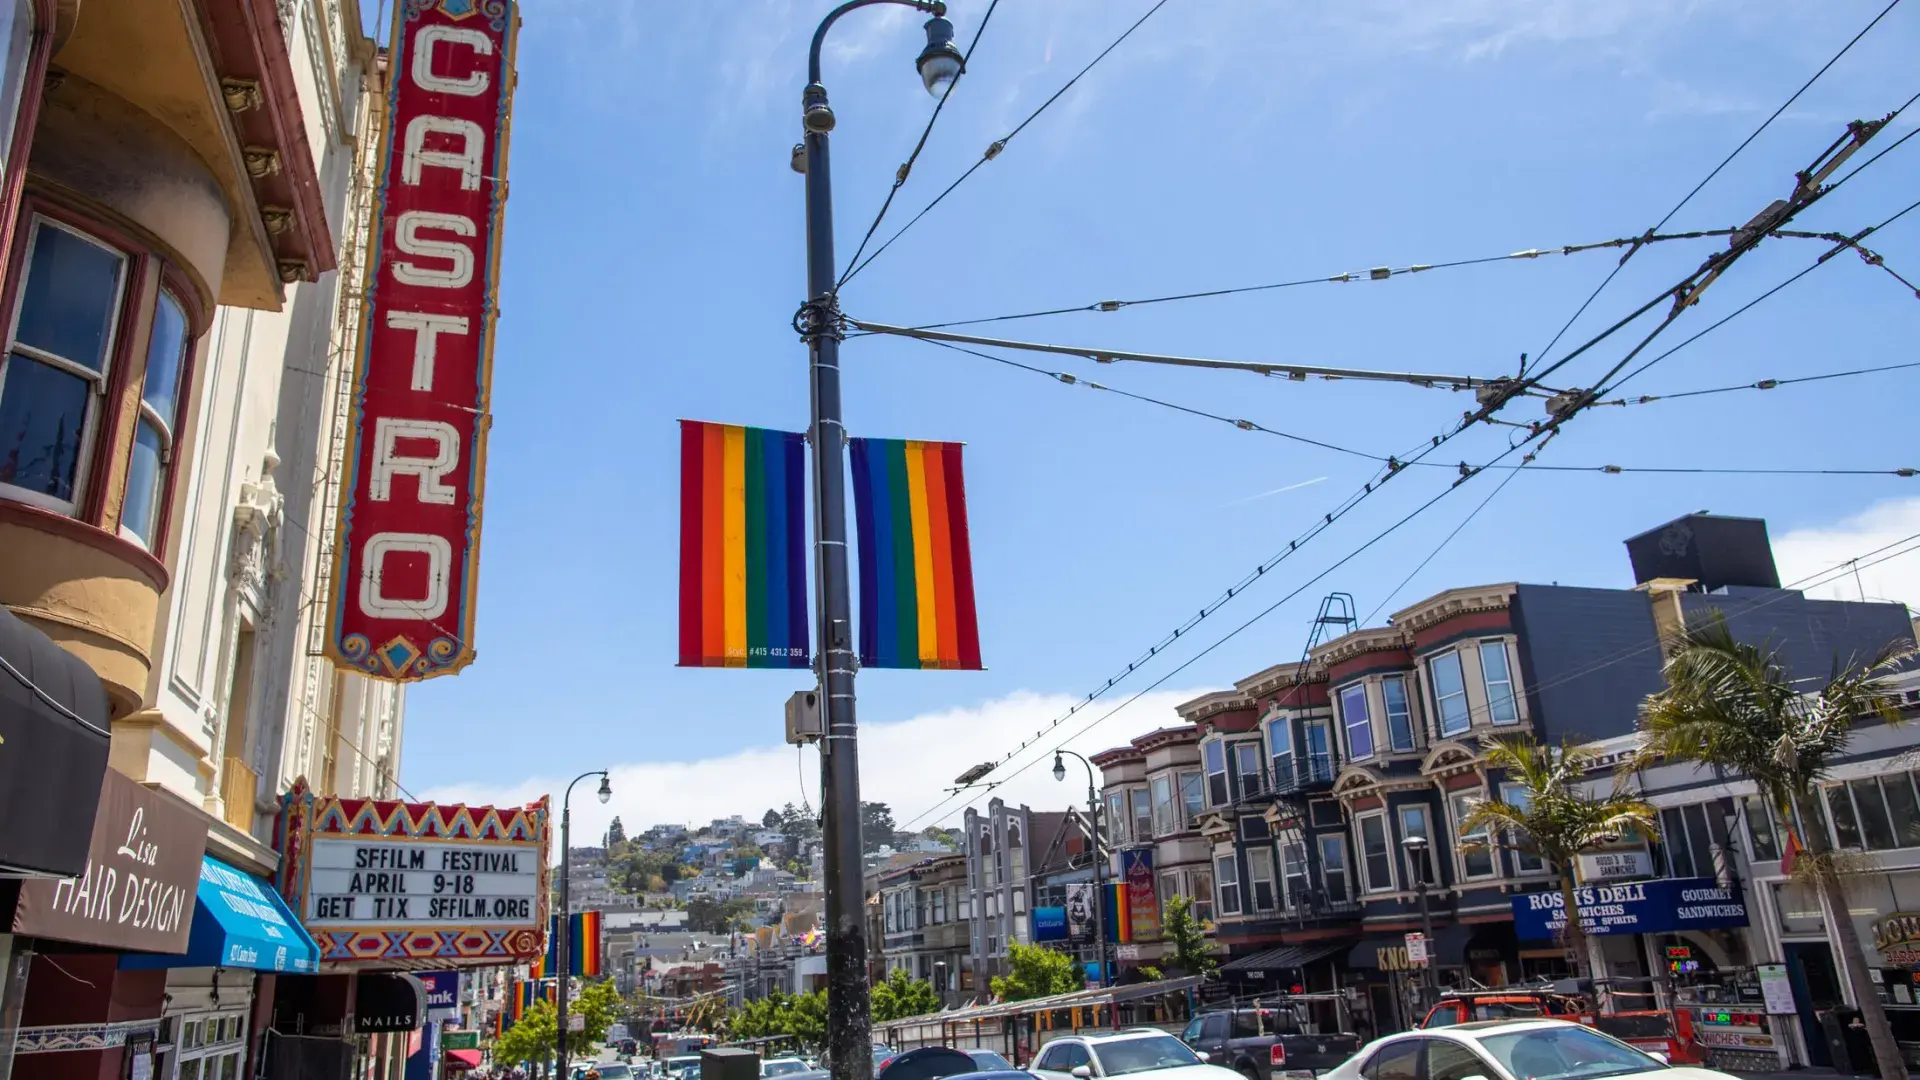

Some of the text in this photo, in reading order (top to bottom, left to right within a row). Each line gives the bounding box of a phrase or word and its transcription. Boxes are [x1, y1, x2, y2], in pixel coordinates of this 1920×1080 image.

[359, 24, 492, 620] CASTRO
[117, 807, 158, 867] Lisa
[356, 848, 518, 872] SFFILM FESTIVAL
[350, 873, 474, 894] APRIL 9-18
[52, 859, 117, 923] HAIR
[118, 873, 186, 933] DESIGN
[1597, 884, 1647, 904] DELI
[1681, 888, 1732, 902] GOURMET
[317, 898, 529, 918] GET TIX SFFILM.ORG
[1552, 904, 1625, 920] SAWICHES
[1677, 904, 1744, 919] SANDWICHES
[1602, 915, 1638, 925] SPIRITS
[425, 989, 452, 1004] ank
[362, 1015, 411, 1027] NAILS
